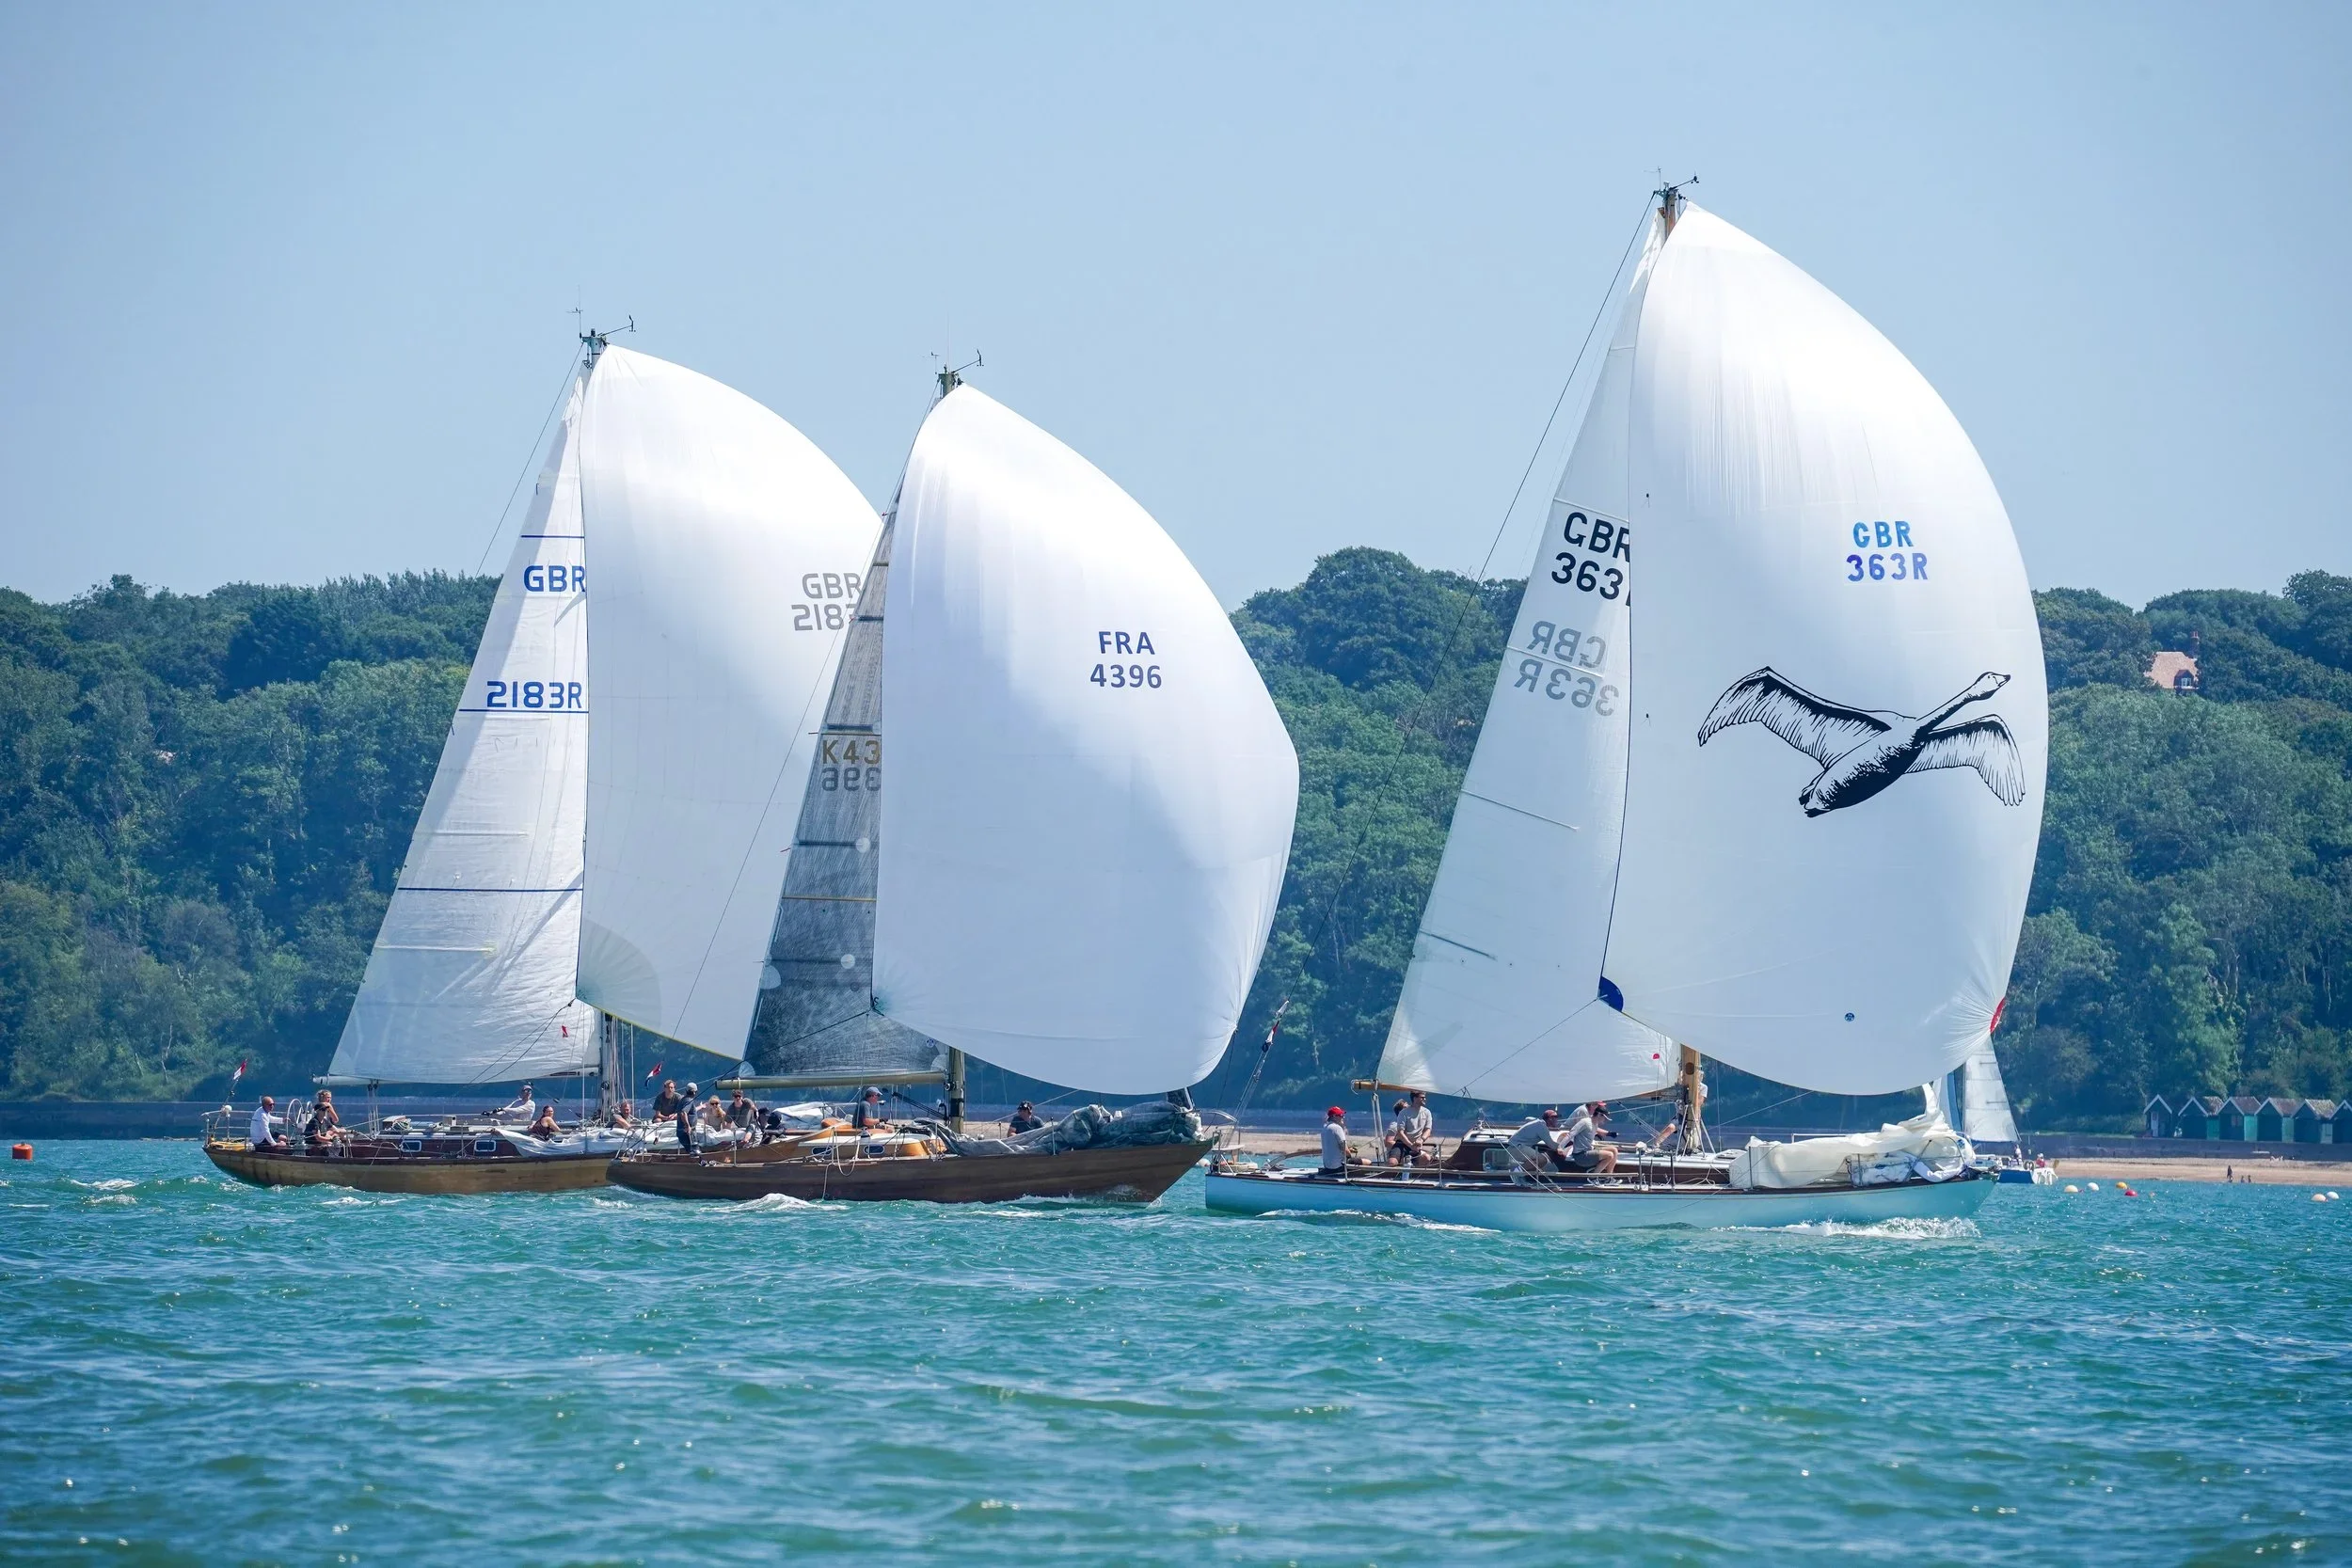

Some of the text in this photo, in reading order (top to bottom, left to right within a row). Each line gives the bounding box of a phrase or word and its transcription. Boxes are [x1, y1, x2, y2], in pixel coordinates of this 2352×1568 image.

[1564, 512, 1629, 562] GBR
[1852, 521, 1914, 548] GBR
[523, 565, 585, 593] GBR
[1551, 552, 1630, 607] 363
[1846, 553, 1928, 581] 363R
[803, 572, 862, 599] GBR
[1098, 631, 1155, 655] FRA
[1089, 663, 1162, 689] 4396
[486, 680, 582, 708] 2183R
[822, 739, 881, 765] K43
